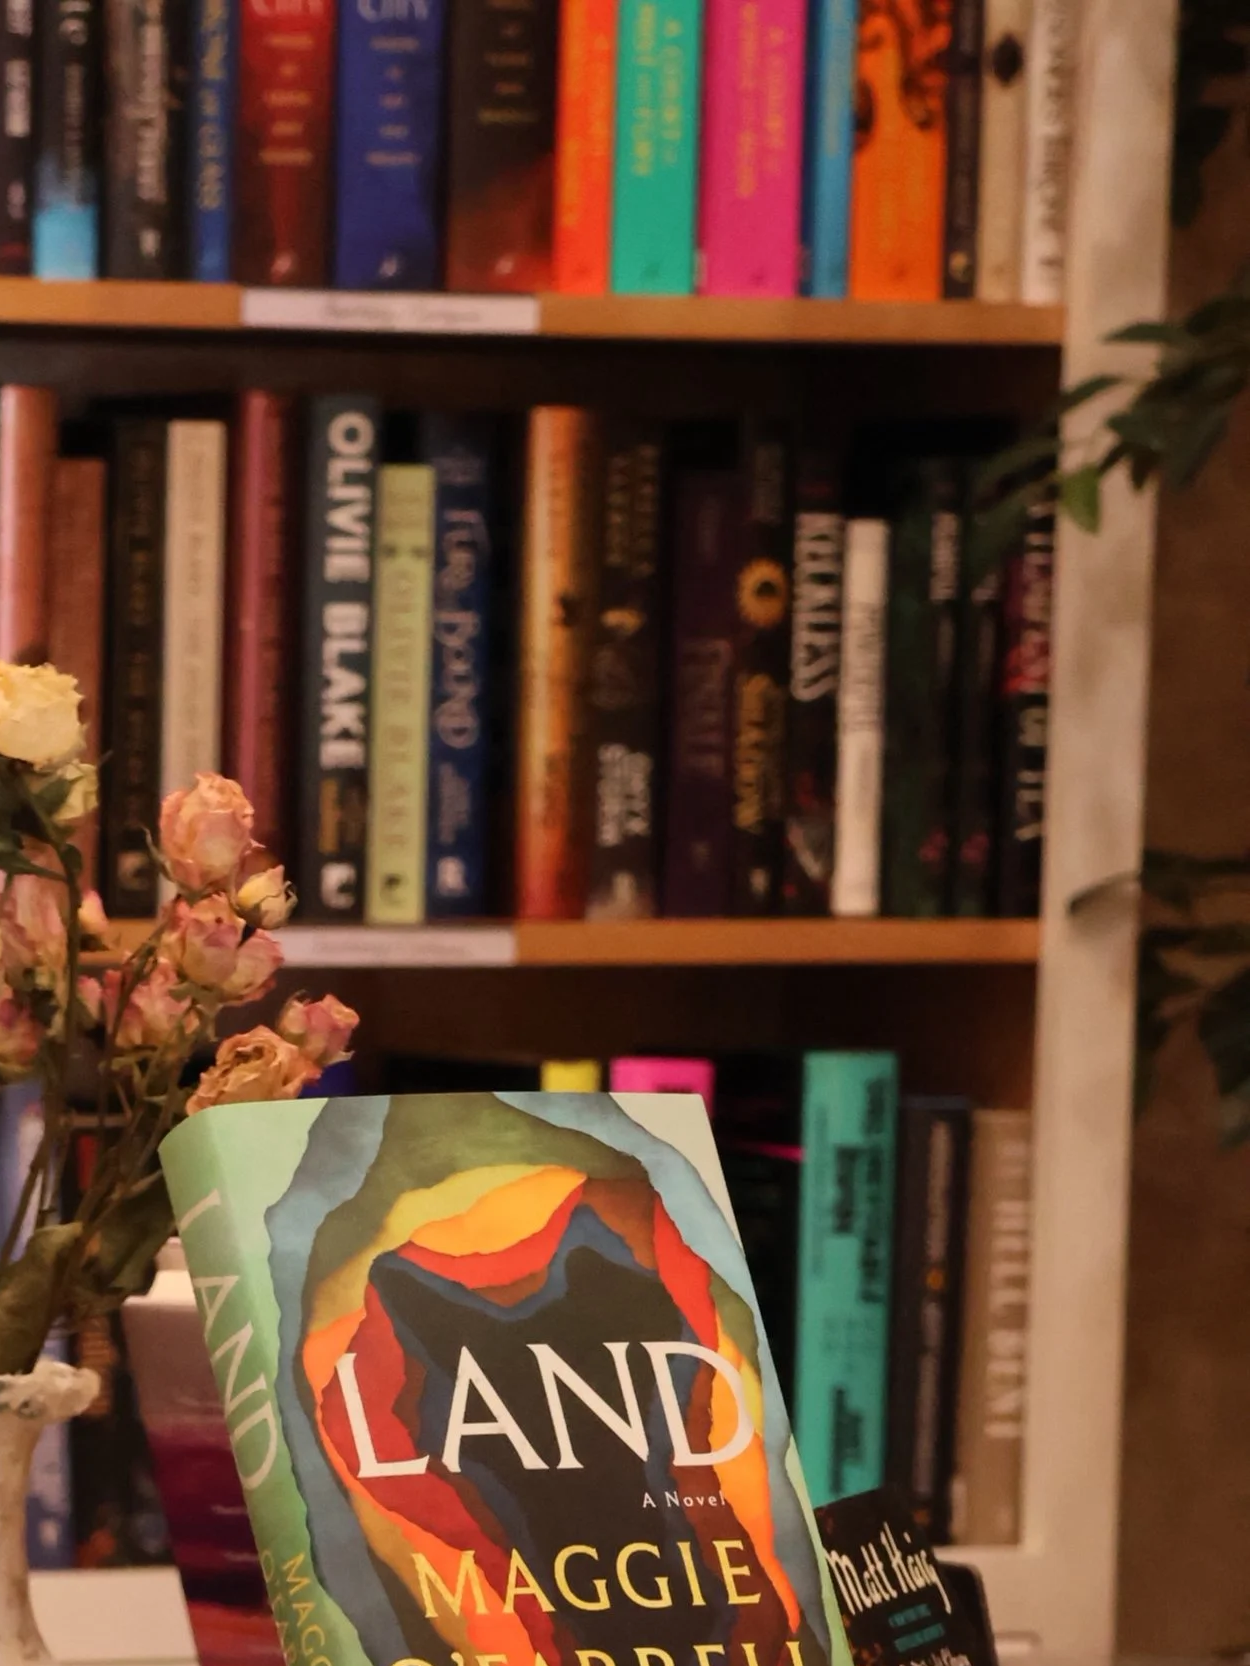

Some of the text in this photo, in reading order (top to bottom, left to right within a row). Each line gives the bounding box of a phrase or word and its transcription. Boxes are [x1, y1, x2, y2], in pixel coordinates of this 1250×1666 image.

[322, 410, 375, 583] OLIVIE
[789, 512, 844, 704] RECKLESS
[318, 602, 369, 771] BLAKE
[180, 1188, 280, 1492] LAND
[335, 1339, 756, 1479] LAND
[642, 1490, 727, 1509] A Novel
[826, 1521, 952, 1616] Matt Haig
[412, 1540, 762, 1619] MAGGIE
